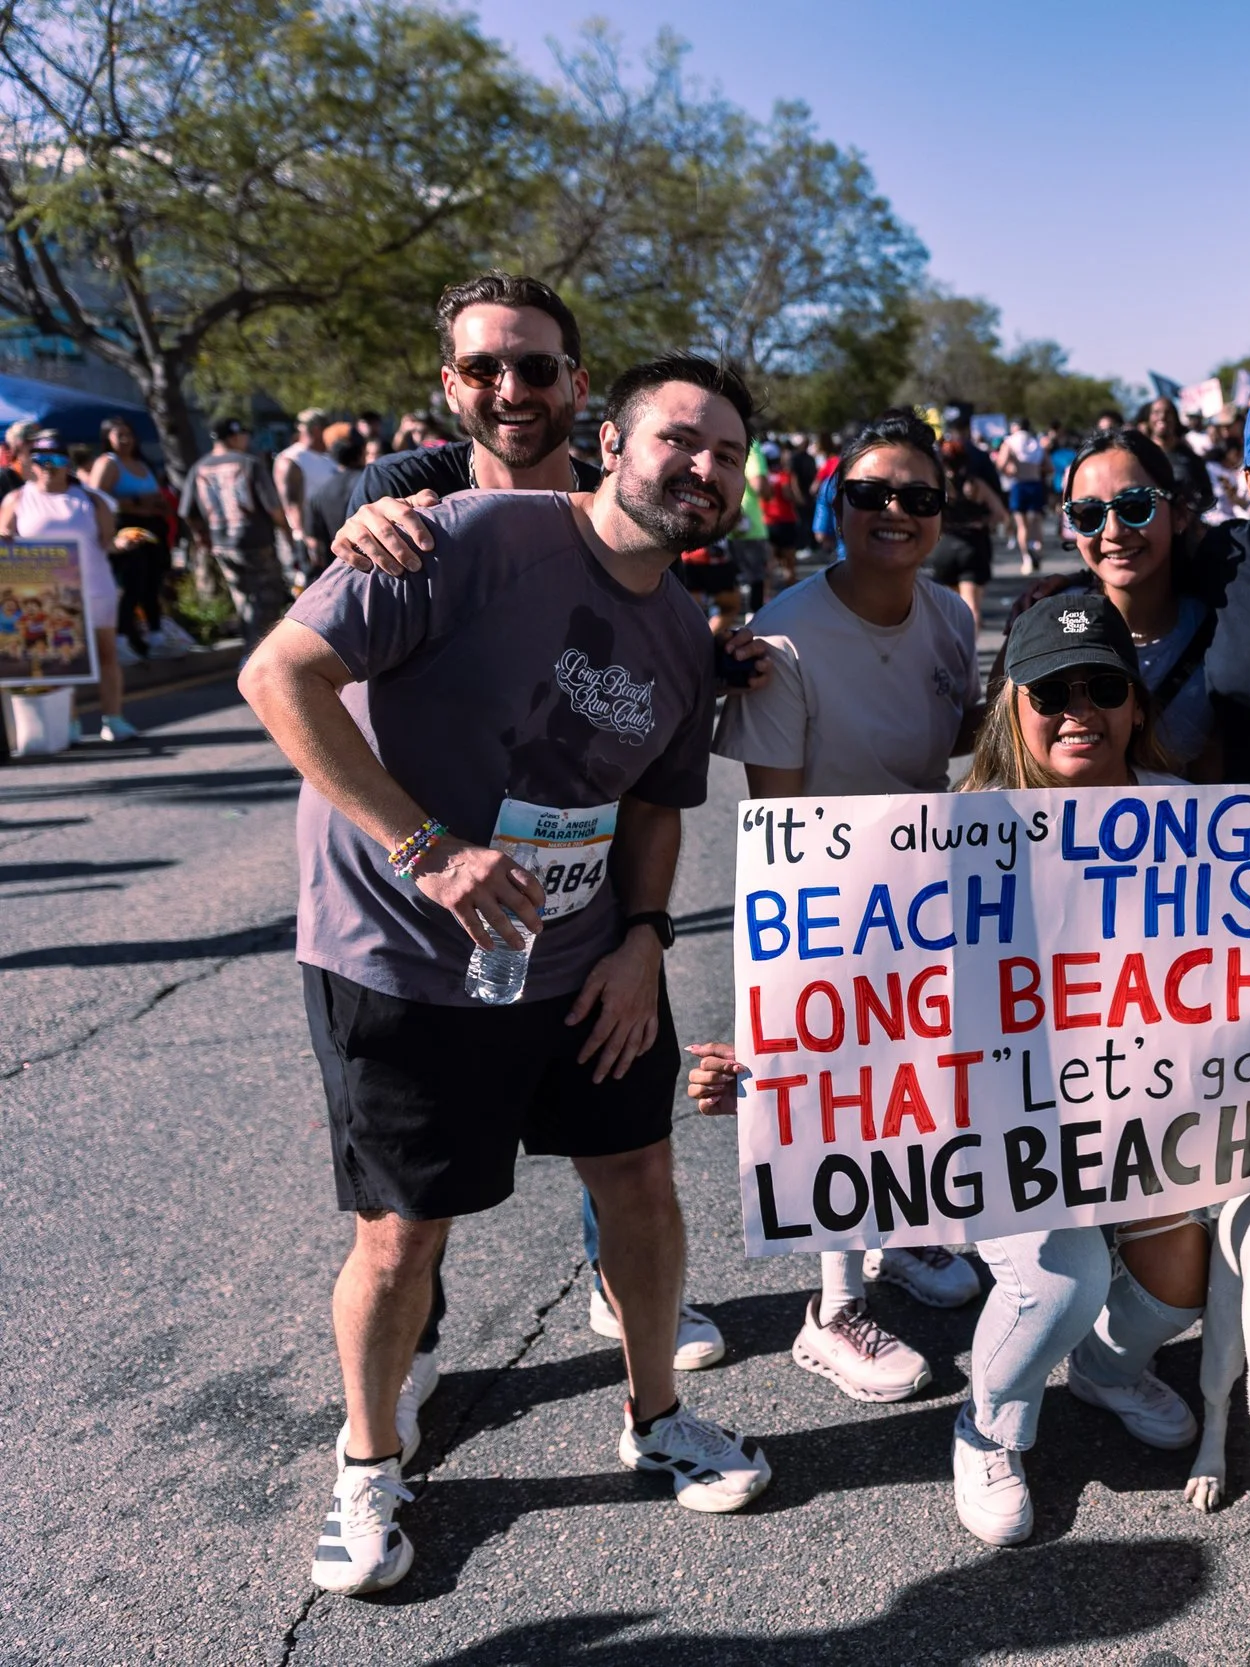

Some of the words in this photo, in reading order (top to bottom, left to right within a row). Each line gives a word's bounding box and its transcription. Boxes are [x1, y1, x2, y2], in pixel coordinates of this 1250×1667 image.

[560, 652, 601, 692] Long
[603, 669, 649, 704] Beach
[574, 685, 610, 715] Run
[612, 699, 649, 726] Club
[534, 827, 597, 840] MARATHON
[537, 819, 559, 829] LOS
[565, 817, 599, 829] ANGELES
[890, 803, 1050, 870] always
[745, 873, 1016, 961] BEACH
[748, 965, 952, 1056] LONG
[1022, 1036, 1174, 1113] Let's
[755, 1133, 985, 1242] LONG
